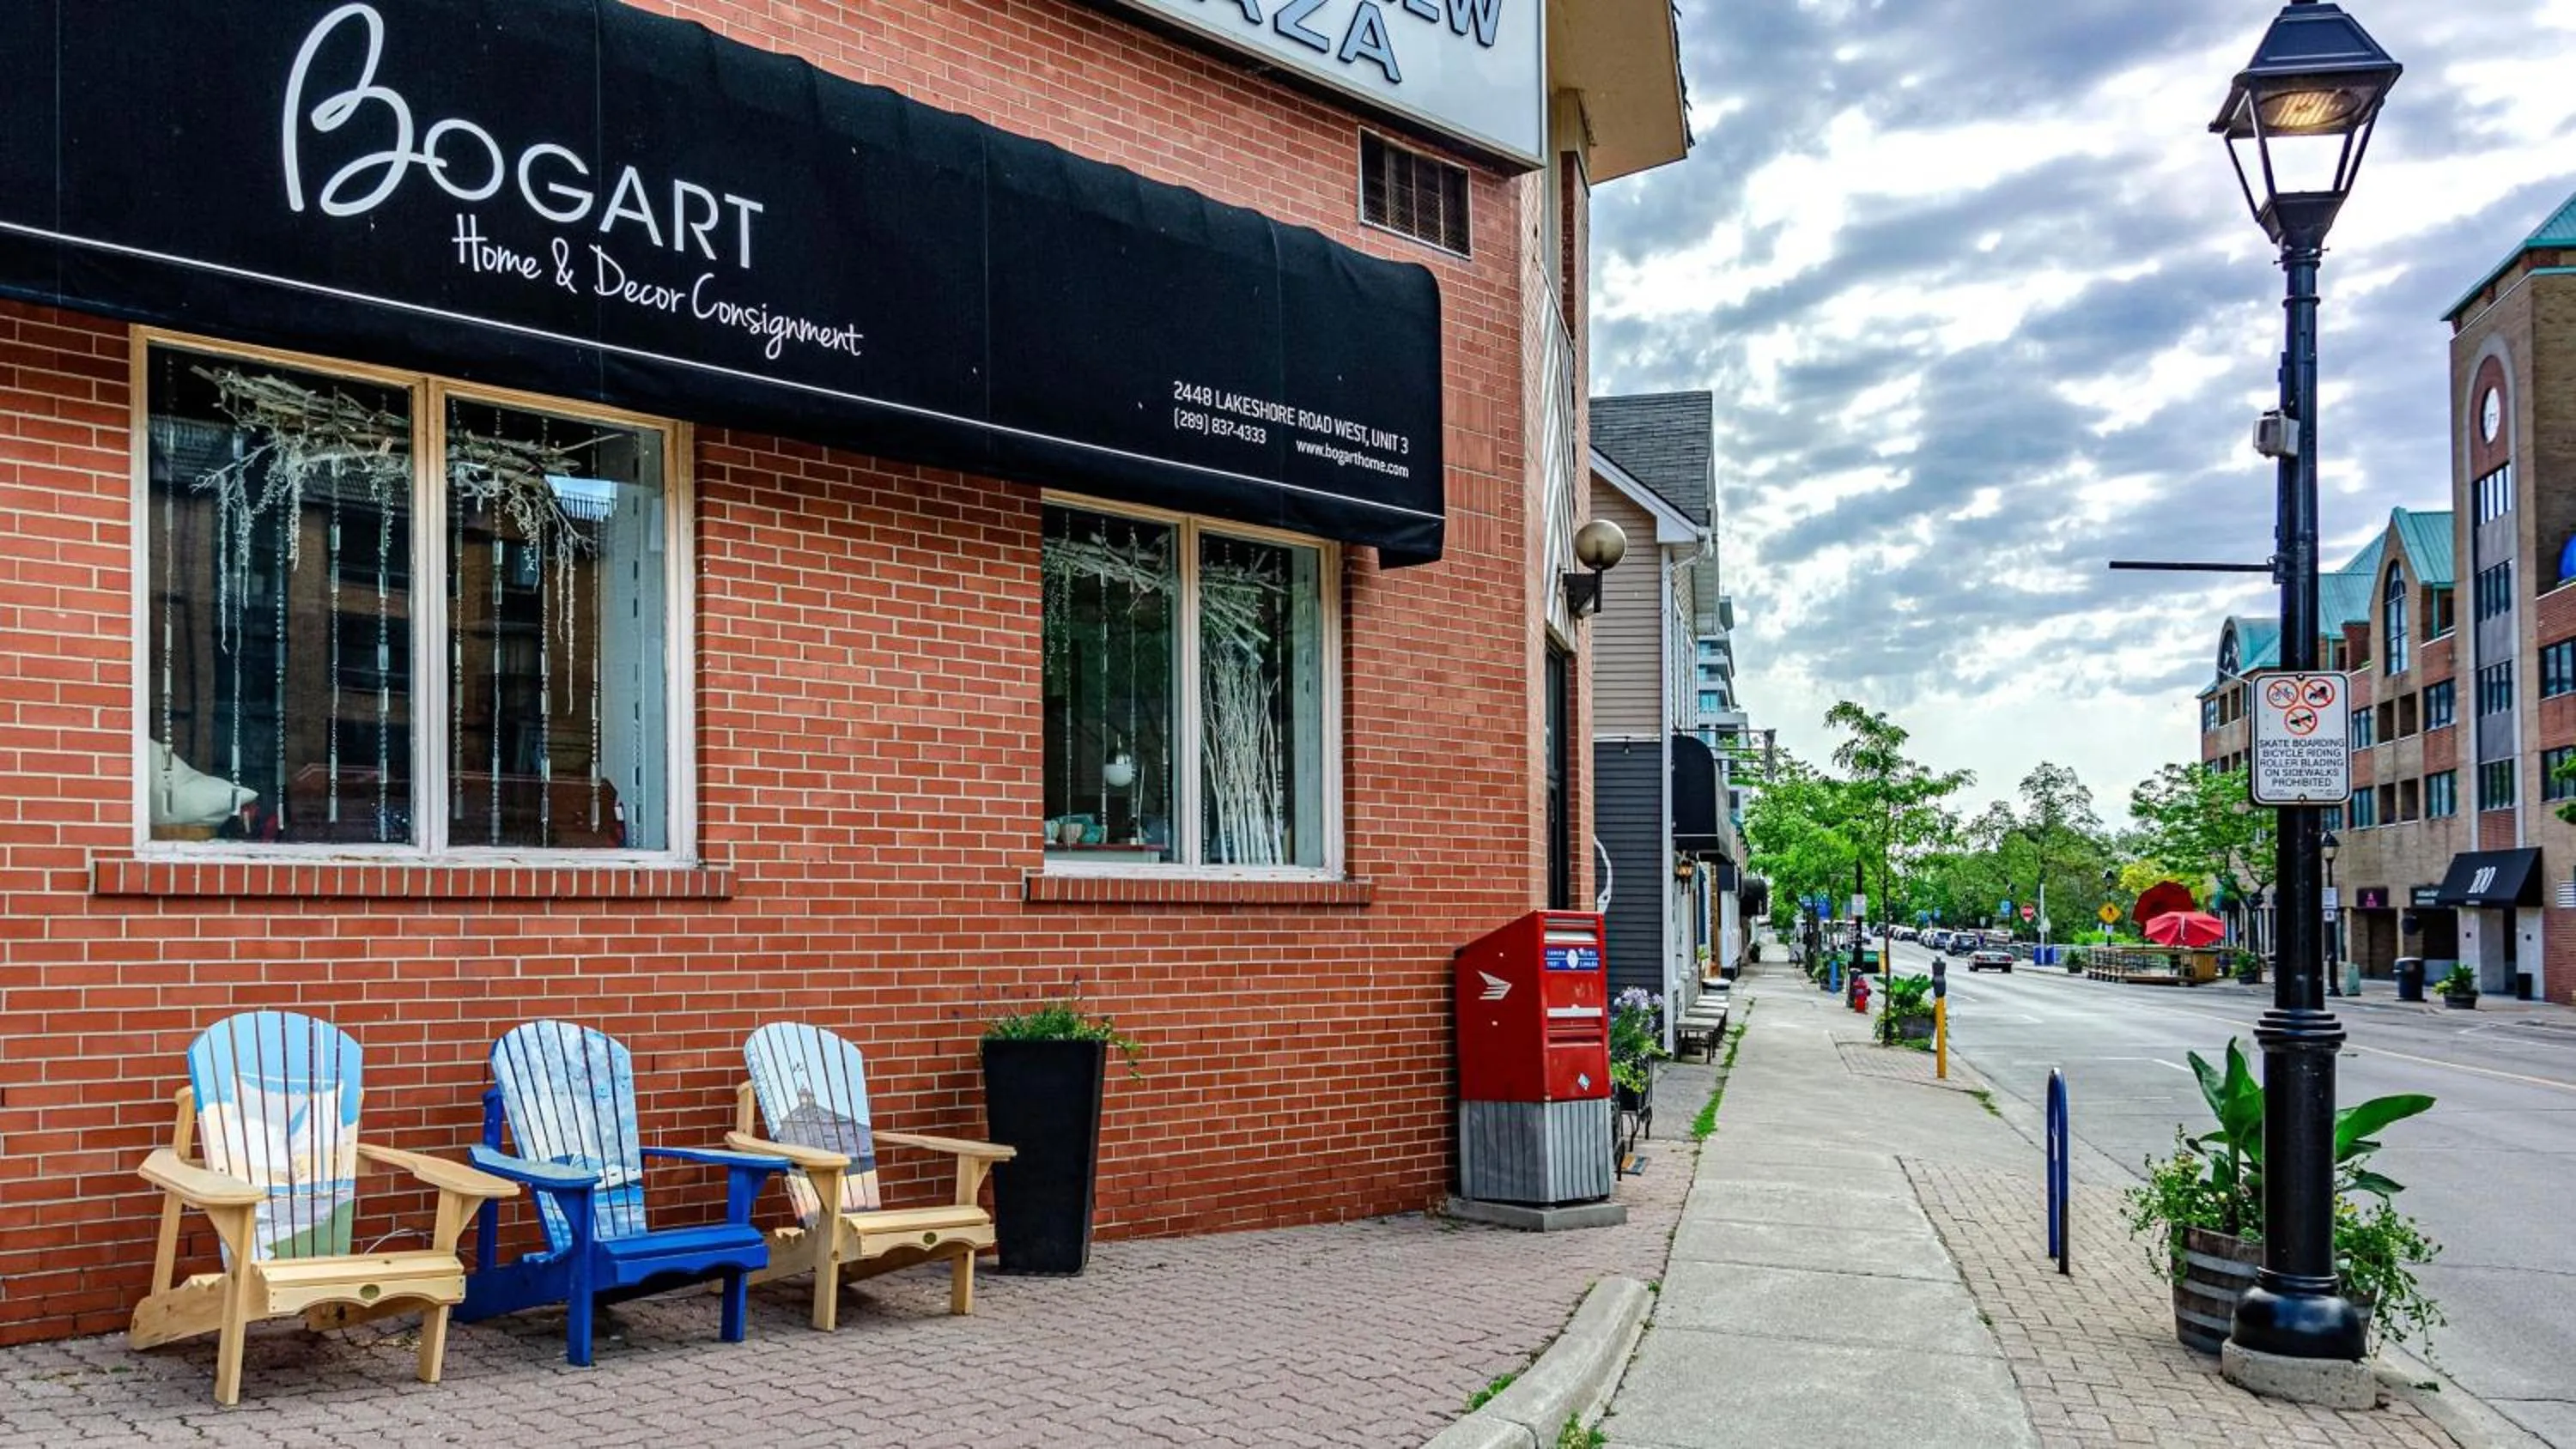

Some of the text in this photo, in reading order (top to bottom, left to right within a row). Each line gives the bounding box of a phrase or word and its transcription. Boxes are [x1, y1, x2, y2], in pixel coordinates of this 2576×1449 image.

[452, 213, 864, 360] Home & Decor Consignment
[1173, 380, 1409, 454] 2448 LAKESHORE ROAD WEST, UNIT 3
[1174, 407, 1267, 445] (289) 837-4333
[1296, 440, 1409, 478] www.bogarthome.com
[2292, 738, 2344, 747] BOARDING
[2263, 749, 2342, 757] BICYCLE RIDING
[2260, 758, 2344, 767] ROLLER BLADING
[2264, 768, 2339, 777] ON SIDEWALKS
[2272, 778, 2333, 787] PROHIBITED
